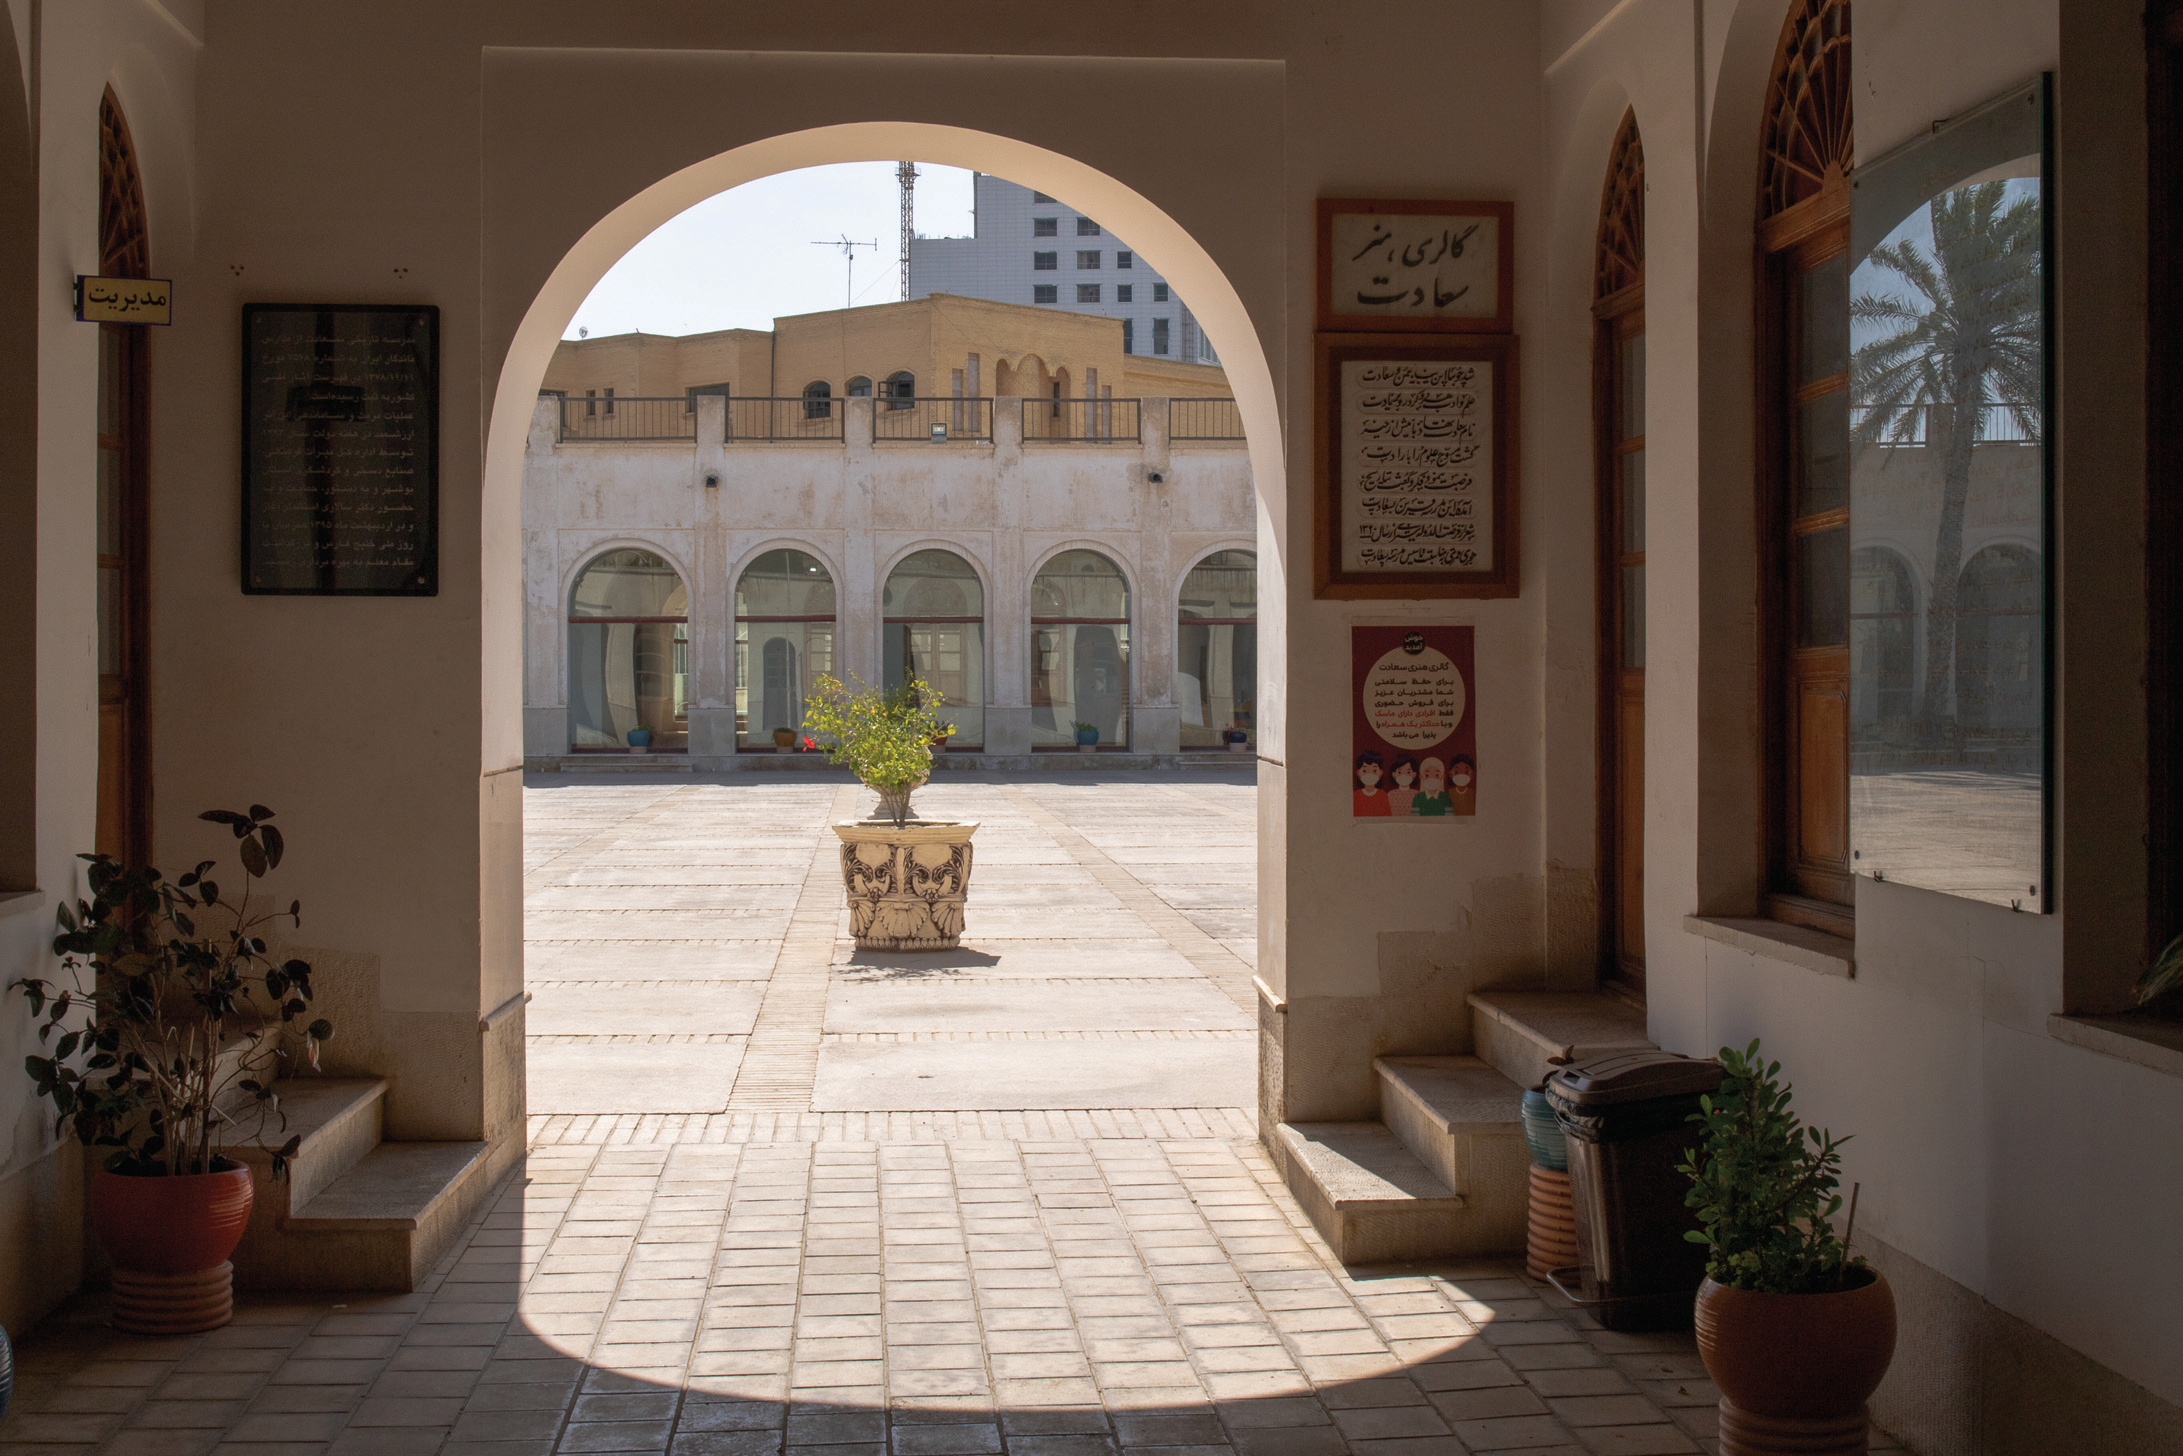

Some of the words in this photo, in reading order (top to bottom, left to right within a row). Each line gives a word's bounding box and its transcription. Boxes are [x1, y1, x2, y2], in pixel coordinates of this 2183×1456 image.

[1402, 222, 1479, 267] گالری
[1357, 276, 1469, 307] سعادت
[88, 288, 167, 312] مدیریت
[294, 335, 302, 345] از
[306, 334, 345, 342] سعادت
[347, 335, 379, 346] تاریخی
[382, 335, 415, 346] مدرسه
[360, 353, 381, 364] ایران
[384, 353, 415, 365] ماندگار
[262, 371, 287, 383] ملی
[314, 371, 348, 384] فهرست
[1362, 366, 1394, 381] سعادت
[362, 392, 378, 400] ثبت
[295, 410, 346, 423] ساماندهی
[358, 410, 380, 422] مرمت
[384, 410, 414, 423] عملیات
[1423, 418, 1467, 437] سعادت
[313, 428, 336, 440] دولت
[374, 428, 415, 440] ارزشمند
[1458, 422, 1475, 446] نام
[305, 446, 334, 459] میراث
[355, 447, 376, 458] اداره
[379, 446, 414, 458] توسط
[1419, 447, 1438, 467] علوم
[1449, 444, 1480, 463] گشت
[353, 466, 382, 477] دستی
[385, 465, 414, 478] صنایع
[381, 484, 414, 496] بوشهر
[320, 501, 352, 513] سالاری
[355, 502, 374, 514] دکتر
[376, 502, 414, 514] حضور
[321, 538, 351, 550] فارس
[353, 539, 376, 551] خلیج
[379, 540, 395, 550] ملی
[397, 539, 414, 550] روز
[365, 557, 389, 568] معلم
[391, 557, 414, 569] مقام
[1361, 549, 1389, 566] سعادت
[1404, 634, 1424, 642] خوش
[1405, 642, 1423, 650] آمدید
[1379, 662, 1407, 671] سعادت
[1408, 663, 1428, 672] هنری
[1429, 662, 1449, 672] گالری
[1375, 678, 1407, 686] سلامتی
[1436, 677, 1454, 686] برای
[1397, 688, 1433, 697] مشتریان
[1374, 699, 1404, 708] حضوری
[1408, 698, 1434, 707] فروش
[1438, 698, 1454, 707] برای
[1374, 709, 1395, 717] ماسک
[1398, 709, 1413, 718] دارای
[1415, 709, 1436, 718] افرادی
[1381, 720, 1406, 728] همراه
[1406, 720, 1419, 728] یک
[1418, 720, 1440, 728] حداکثر
[1422, 731, 1436, 740] پذیرا
